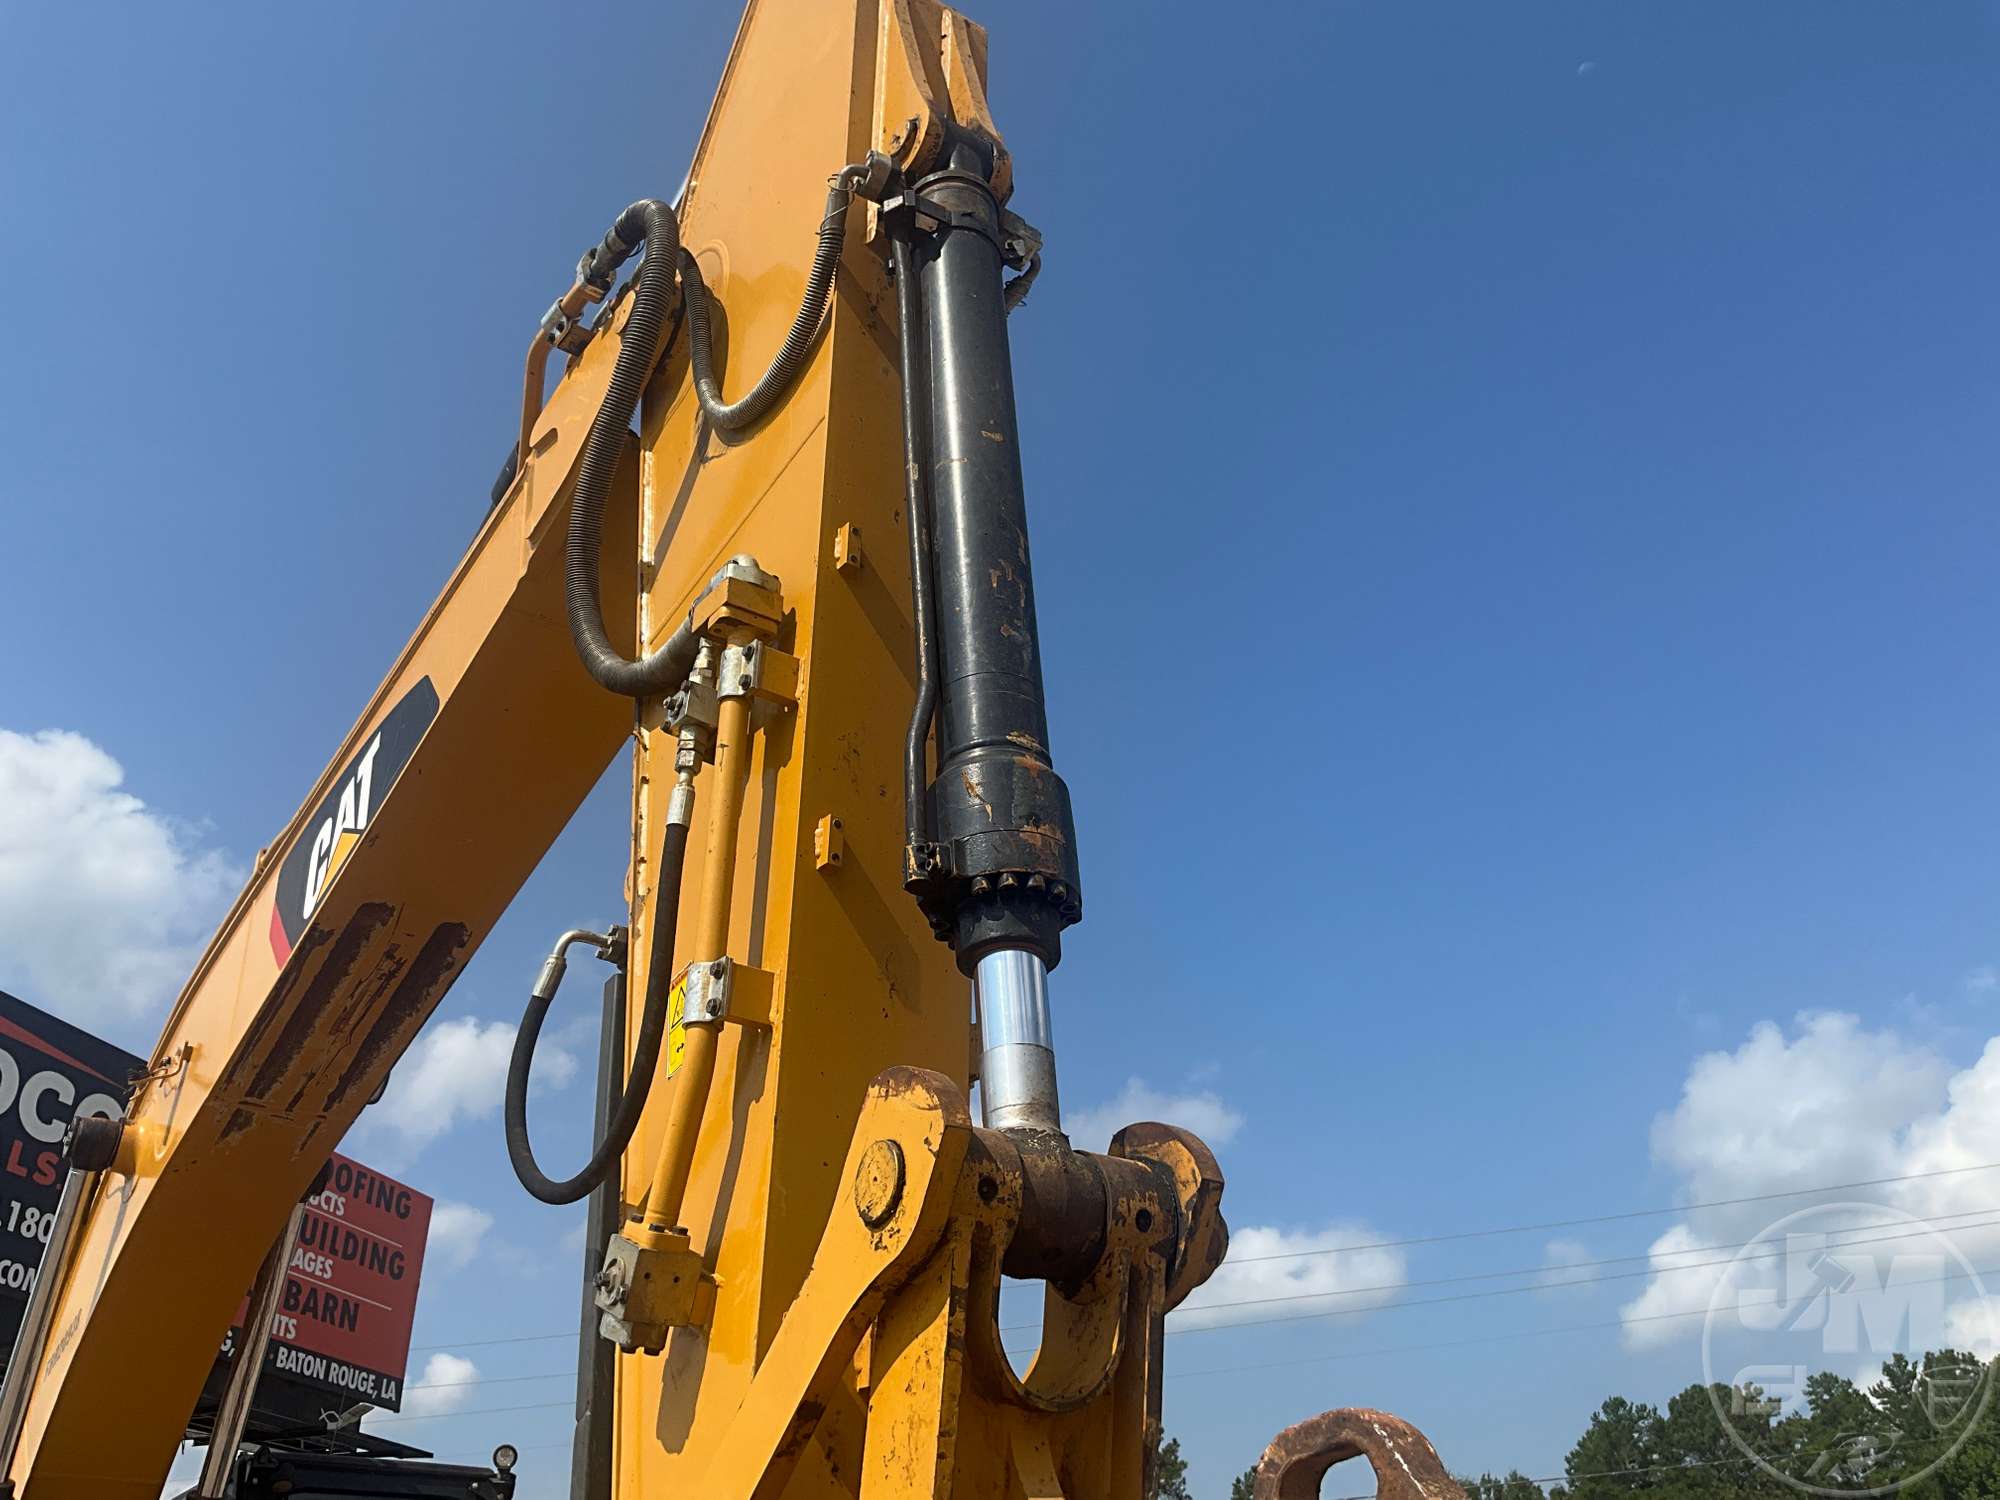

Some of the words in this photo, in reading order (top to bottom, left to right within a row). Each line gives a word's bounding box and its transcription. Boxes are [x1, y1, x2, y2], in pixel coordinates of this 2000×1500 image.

[303, 731, 381, 919] CAT
[299, 1213, 405, 1280] UILDING
[284, 1280, 360, 1332] BARN
[276, 1346, 326, 1380] BATON
[328, 1362, 378, 1399] ROUGE,
[381, 1378, 396, 1401] LA
